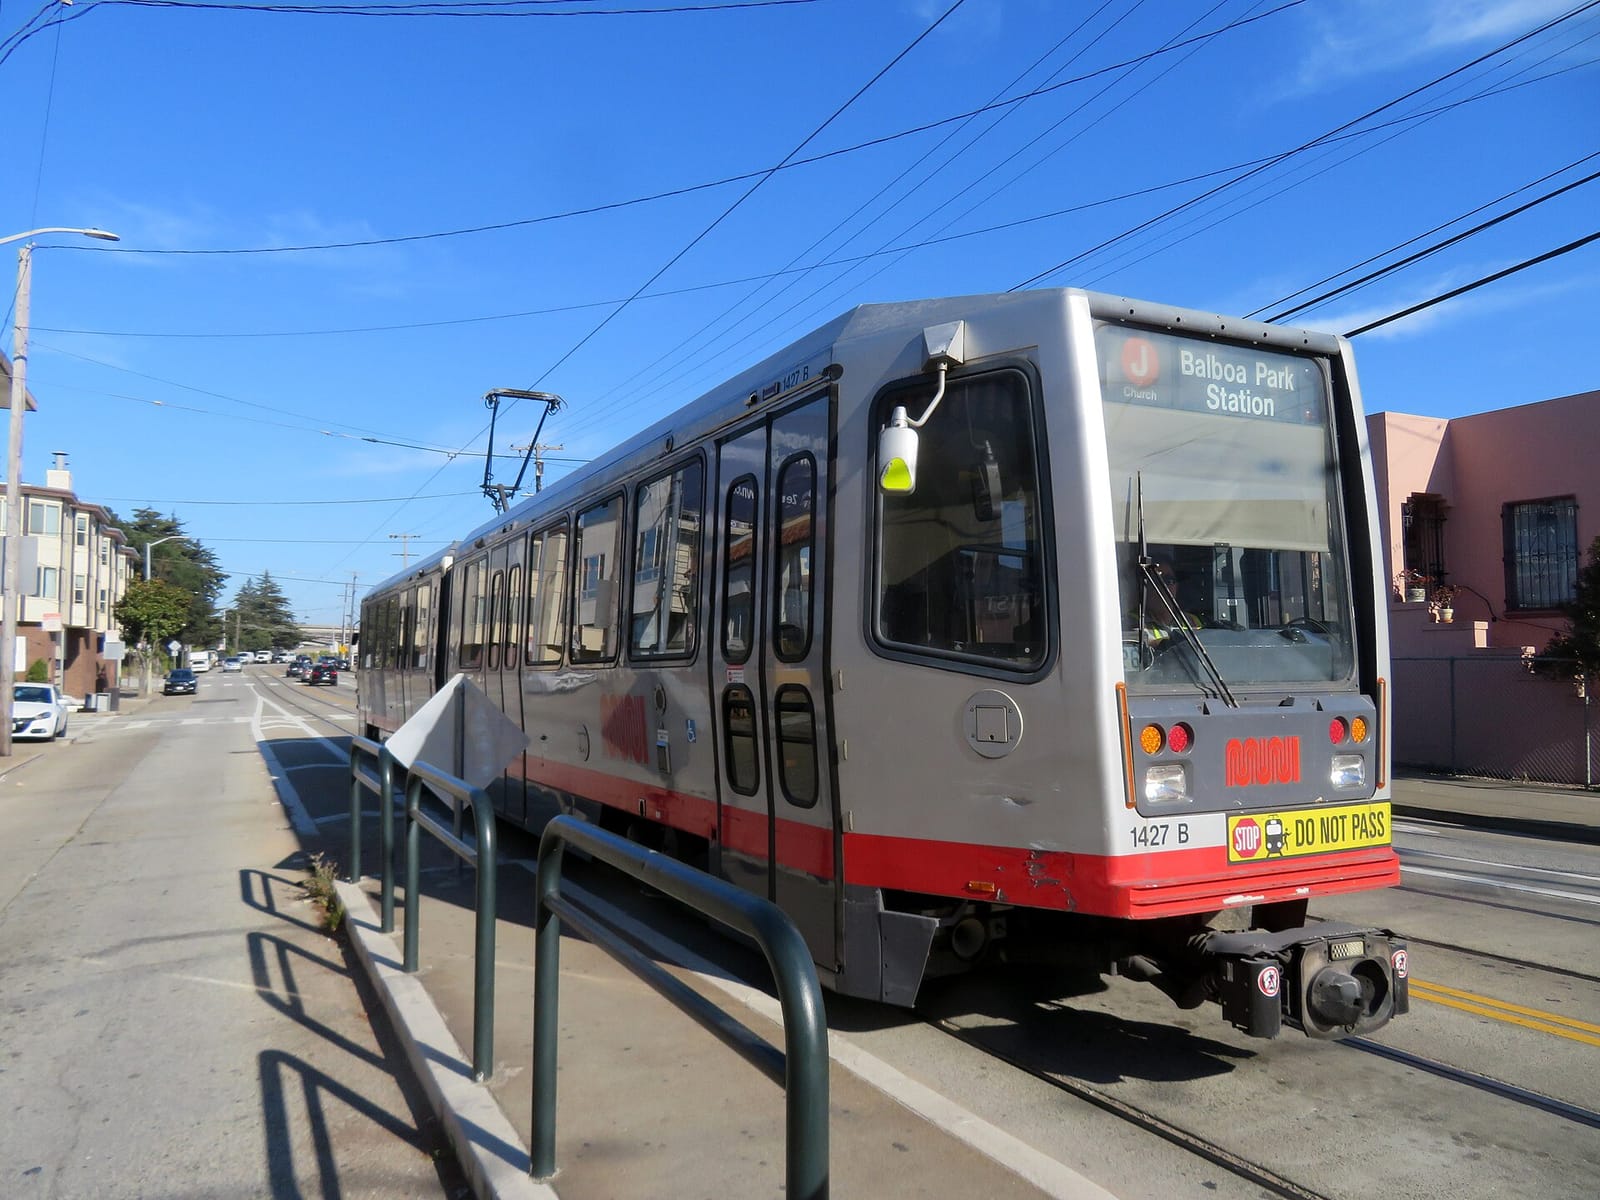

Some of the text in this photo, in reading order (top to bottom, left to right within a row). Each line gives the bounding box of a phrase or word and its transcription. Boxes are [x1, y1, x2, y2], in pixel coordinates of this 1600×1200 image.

[1130, 346, 1148, 377] J
[1181, 350, 1295, 391] Balboa Park
[783, 366, 809, 391] 1427 B
[1123, 386, 1157, 401] Church
[1206, 384, 1274, 416] Station
[1130, 823, 1189, 847] 1427 B
[1235, 826, 1260, 851] STOP
[1295, 811, 1385, 847] DO NOT PASS
